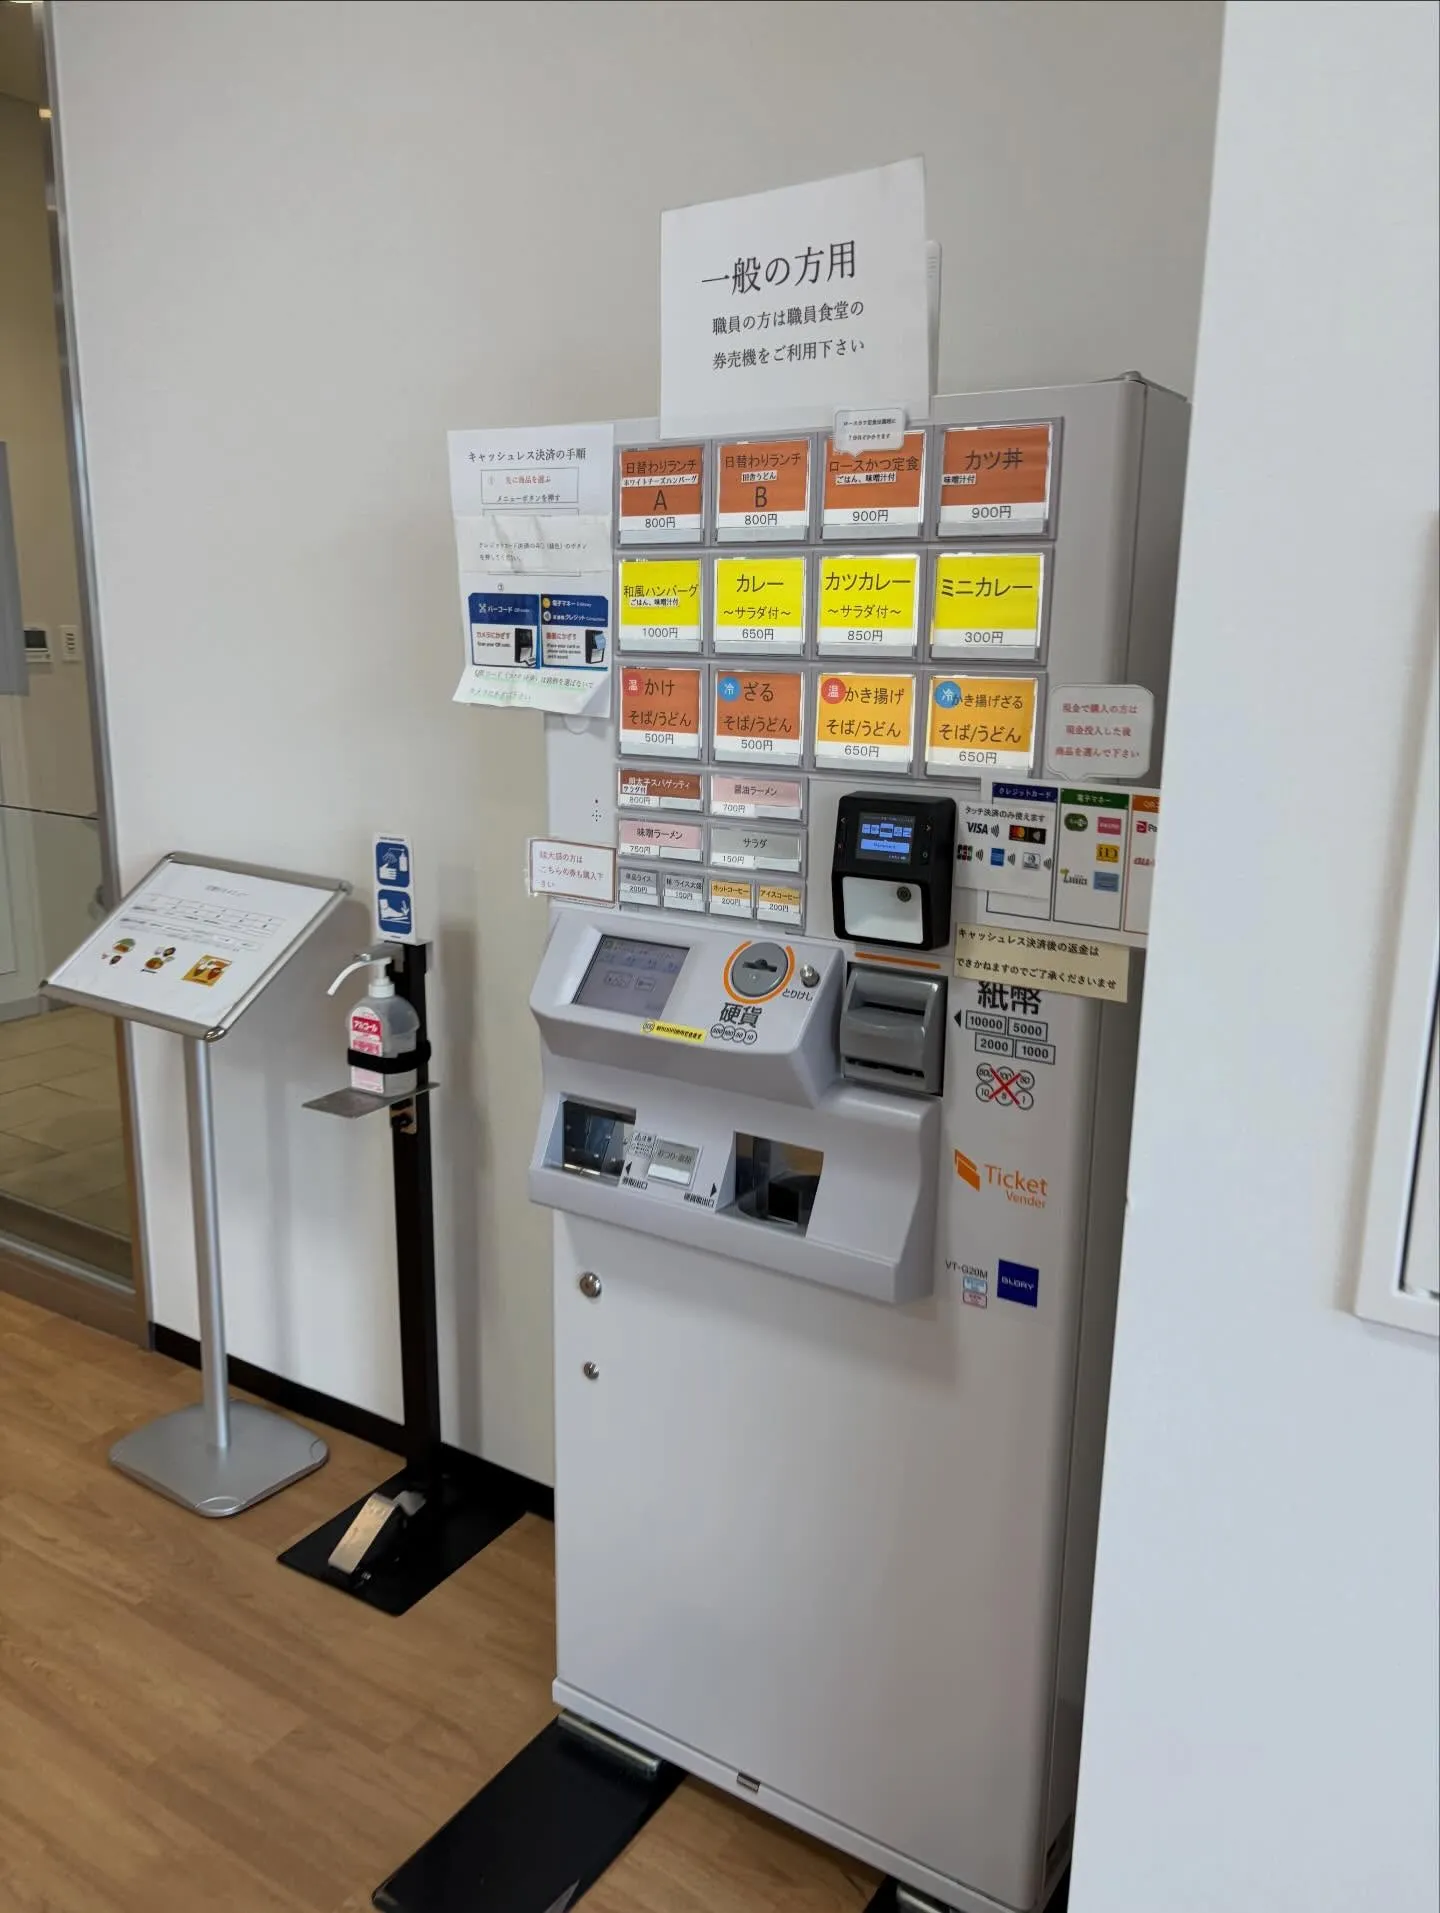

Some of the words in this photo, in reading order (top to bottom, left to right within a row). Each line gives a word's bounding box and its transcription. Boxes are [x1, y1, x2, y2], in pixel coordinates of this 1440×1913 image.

[701, 240, 856, 296] 一般の方用
[712, 300, 864, 336] 職員の方は職員食堂の
[712, 338, 865, 371] 券売機をご利用下さい
[468, 447, 587, 463] キャッシュレス決済の手順
[725, 453, 802, 469] 日替わりランチ
[965, 448, 1023, 471] カツ丼
[626, 459, 697, 475] 日替わりランチ
[829, 456, 920, 472] ロースかつ定食
[623, 475, 698, 486] ホワイトチーズハンバーグ
[742, 471, 777, 482] 田舎うどん
[943, 474, 976, 484] 味噌汁付
[653, 489, 668, 511] A
[755, 486, 768, 508] B
[852, 509, 889, 523] 900円
[971, 505, 1012, 519] 900円
[645, 517, 676, 529] 800円
[744, 513, 778, 526] 800円
[736, 574, 784, 593] カレー
[825, 571, 911, 591] カツカレー
[941, 577, 1033, 597] ミニカレー
[623, 584, 699, 598] 和風ハンバーグ
[487, 606, 513, 614] バーコード
[642, 627, 678, 639] 1000円
[742, 628, 774, 640] 650円
[847, 630, 883, 642] 850円
[964, 631, 1004, 644] 300円
[644, 678, 675, 697] かけ
[724, 683, 735, 696] 冷
[743, 682, 774, 702] ざる
[828, 685, 839, 698] 温
[942, 687, 954, 702] 冷
[844, 687, 904, 705] かき揚げ
[952, 694, 1023, 709] かき揚げざる
[1062, 703, 1138, 714] 現金で購入の方は
[628, 710, 691, 727] そば/うどん
[723, 716, 792, 733] そば/うどん
[826, 719, 901, 738] そば/うどん
[939, 724, 1021, 744] そば/うどん
[1066, 725, 1132, 737] 現金投入した後
[644, 732, 674, 745] 500円
[741, 739, 773, 751] 500円
[844, 745, 880, 757] 650円
[959, 751, 997, 764] 650円
[1055, 746, 1140, 759] 商品を選んで下さい
[628, 776, 690, 790] 明太子スパゲッティ
[999, 787, 1052, 799] クレジットカード
[629, 796, 651, 805] 800円
[723, 804, 746, 813] 700円
[965, 805, 1046, 822] タッチ決済のみ使えます
[967, 822, 988, 834] VISA
[629, 845, 651, 854] 750円
[742, 838, 769, 849] サラダ
[722, 855, 745, 865] 150円
[713, 885, 749, 893] ホットコーヒー
[760, 890, 800, 900] アイスコーヒー
[722, 898, 740, 906] 200円
[769, 904, 789, 912] 200円
[958, 928, 1100, 956] キャッシュレス決済後の返金は
[956, 957, 1117, 989] できかねますのでご了承くださいませ
[782, 989, 814, 1002] とりけし
[977, 980, 1042, 1015] 紙幣
[719, 1002, 763, 1029] 硬貨
[970, 1015, 1003, 1030] 10000
[1013, 1021, 1042, 1036] 5000
[980, 1039, 1008, 1052] 2000
[1022, 1046, 1049, 1059] 1000
[981, 1087, 990, 1097] 10
[984, 1164, 1048, 1196] Ticket
[1006, 1190, 1046, 1209] Vender
[945, 1259, 988, 1280] VT-G20M
[1001, 1276, 1035, 1291] GLORY
